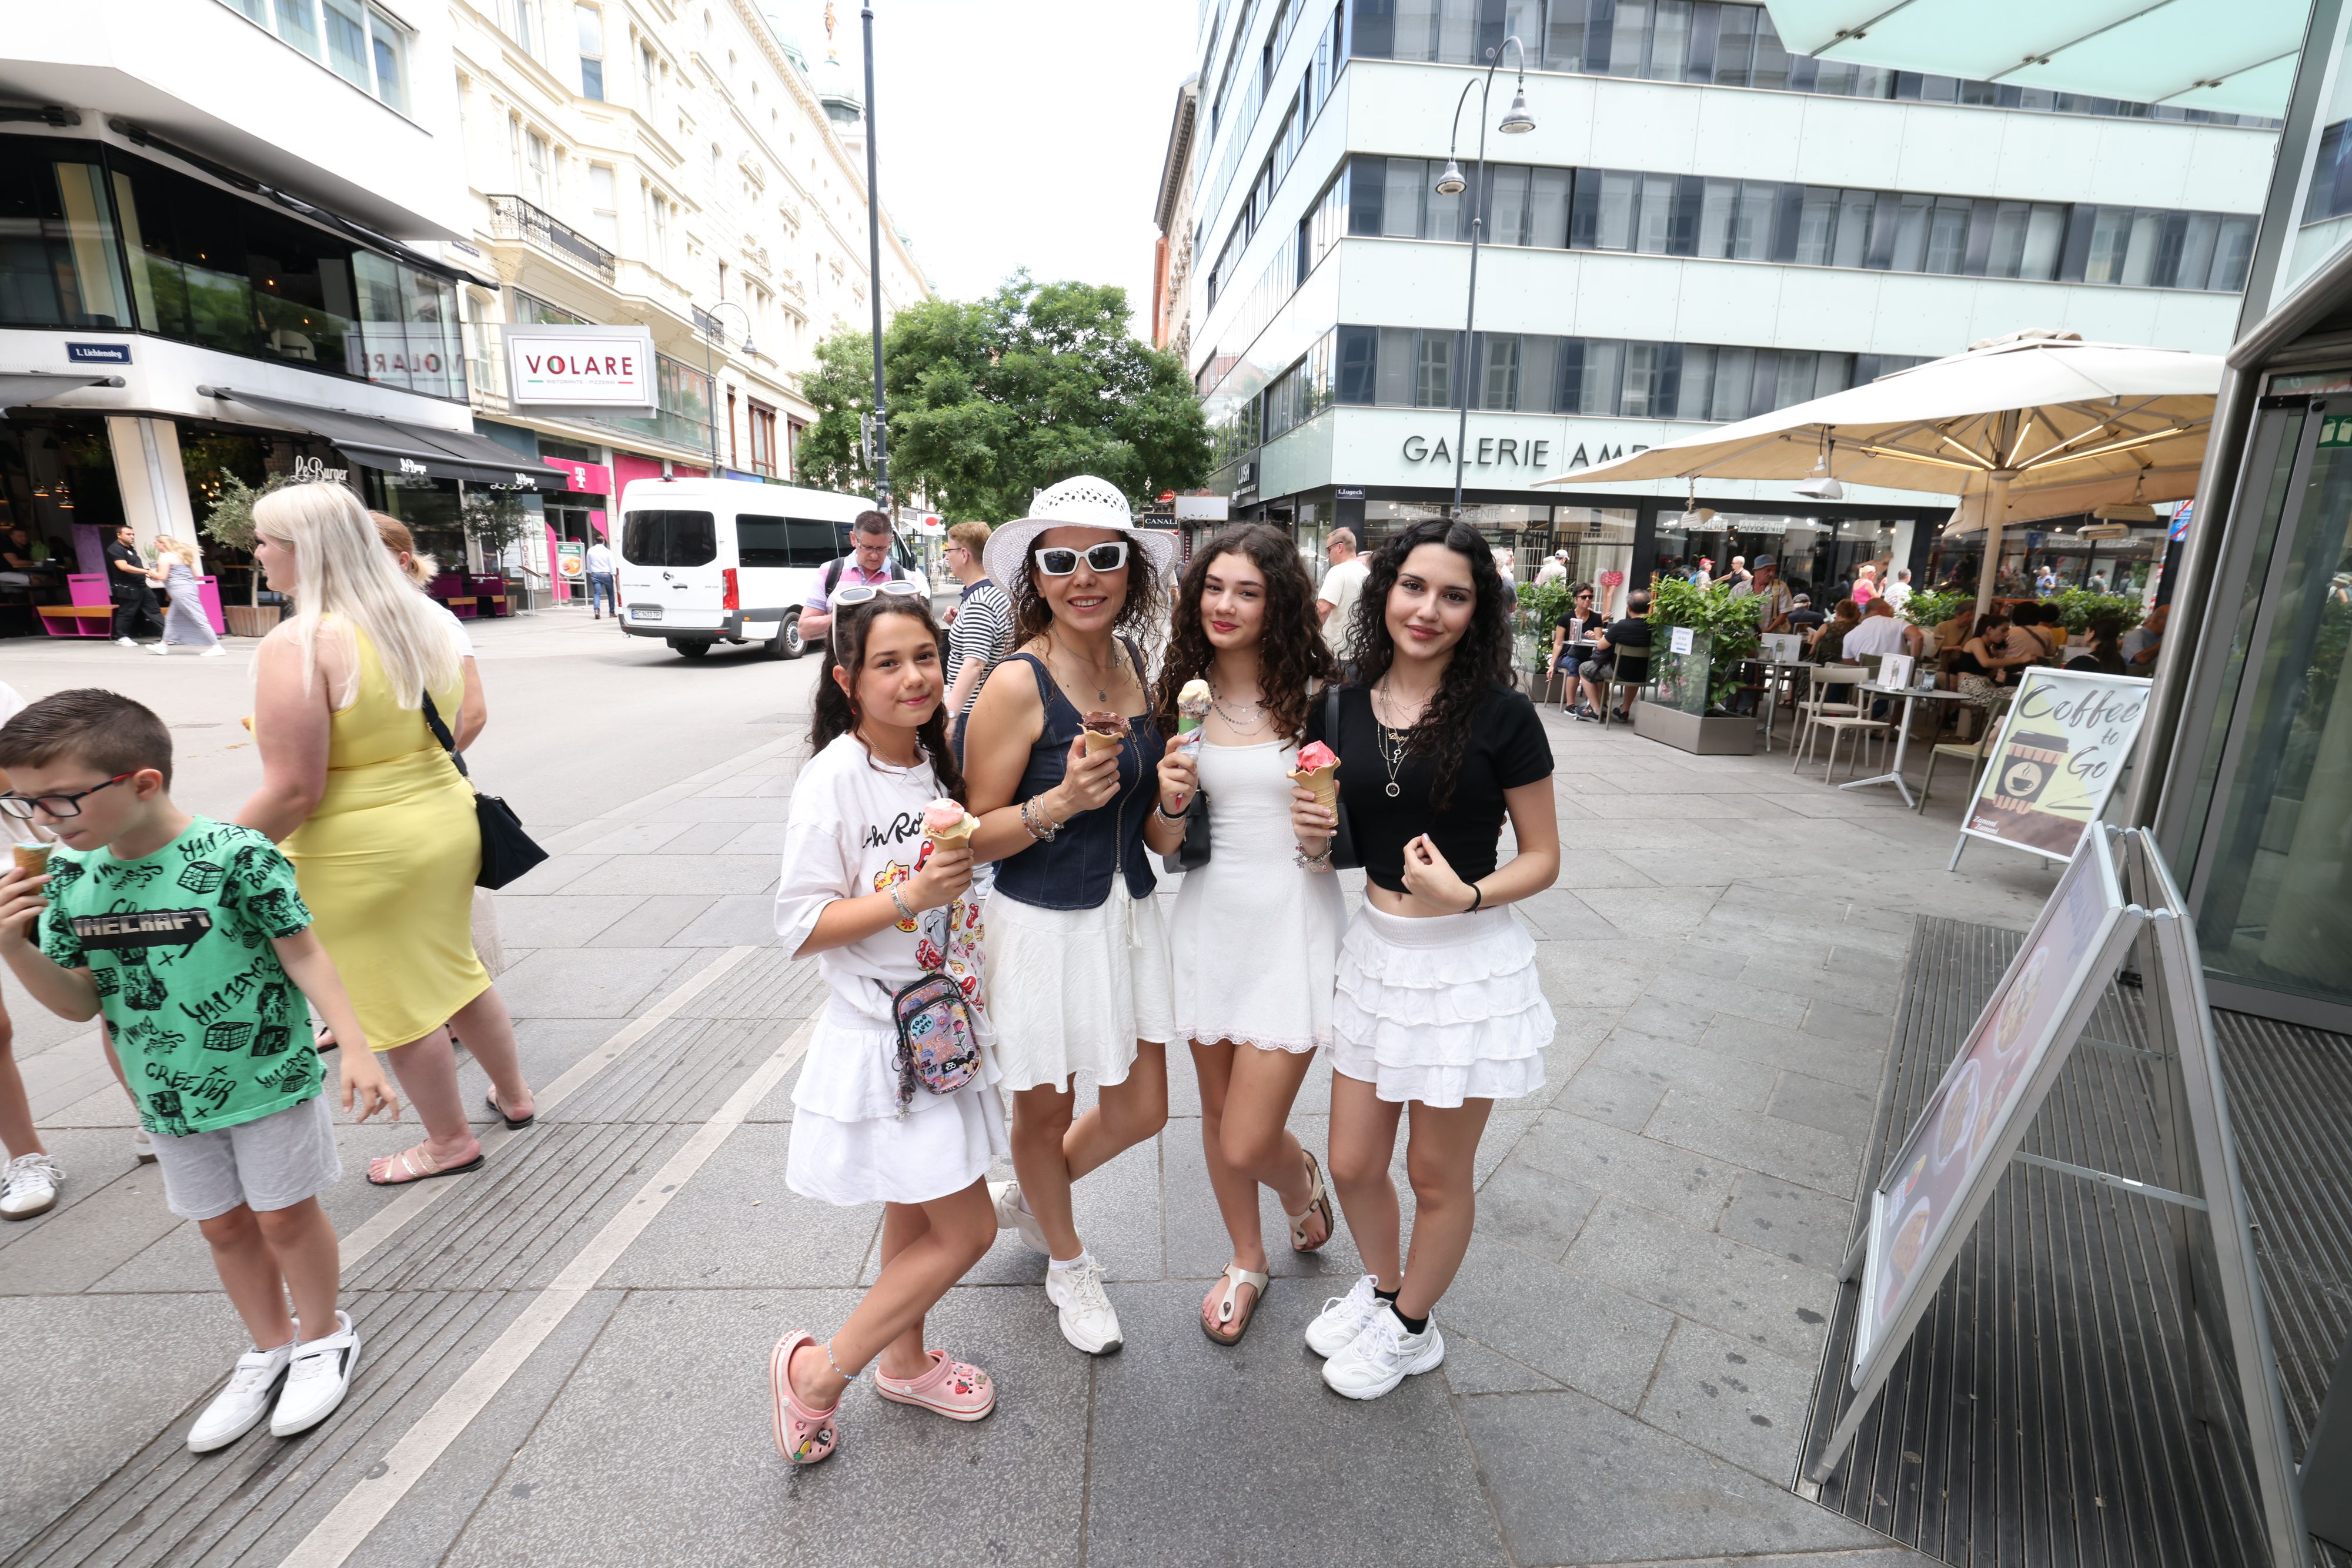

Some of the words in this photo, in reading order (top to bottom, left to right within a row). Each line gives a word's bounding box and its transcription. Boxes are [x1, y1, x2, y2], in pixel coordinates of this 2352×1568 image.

[526, 355, 633, 375] VOLARE
[1238, 463, 1250, 484] LUSH
[1401, 506, 1440, 517] GALERIE
[1459, 508, 1500, 520] MBIENTE
[1739, 521, 1785, 533] AMBIENTE
[2019, 684, 2140, 728] Coffee
[2101, 727, 2119, 745] to
[2067, 746, 2108, 781] Go
[1973, 815, 1999, 827] Zanoni
[1975, 823, 2000, 835] Zanoni
[946, 1063, 957, 1071] 100
